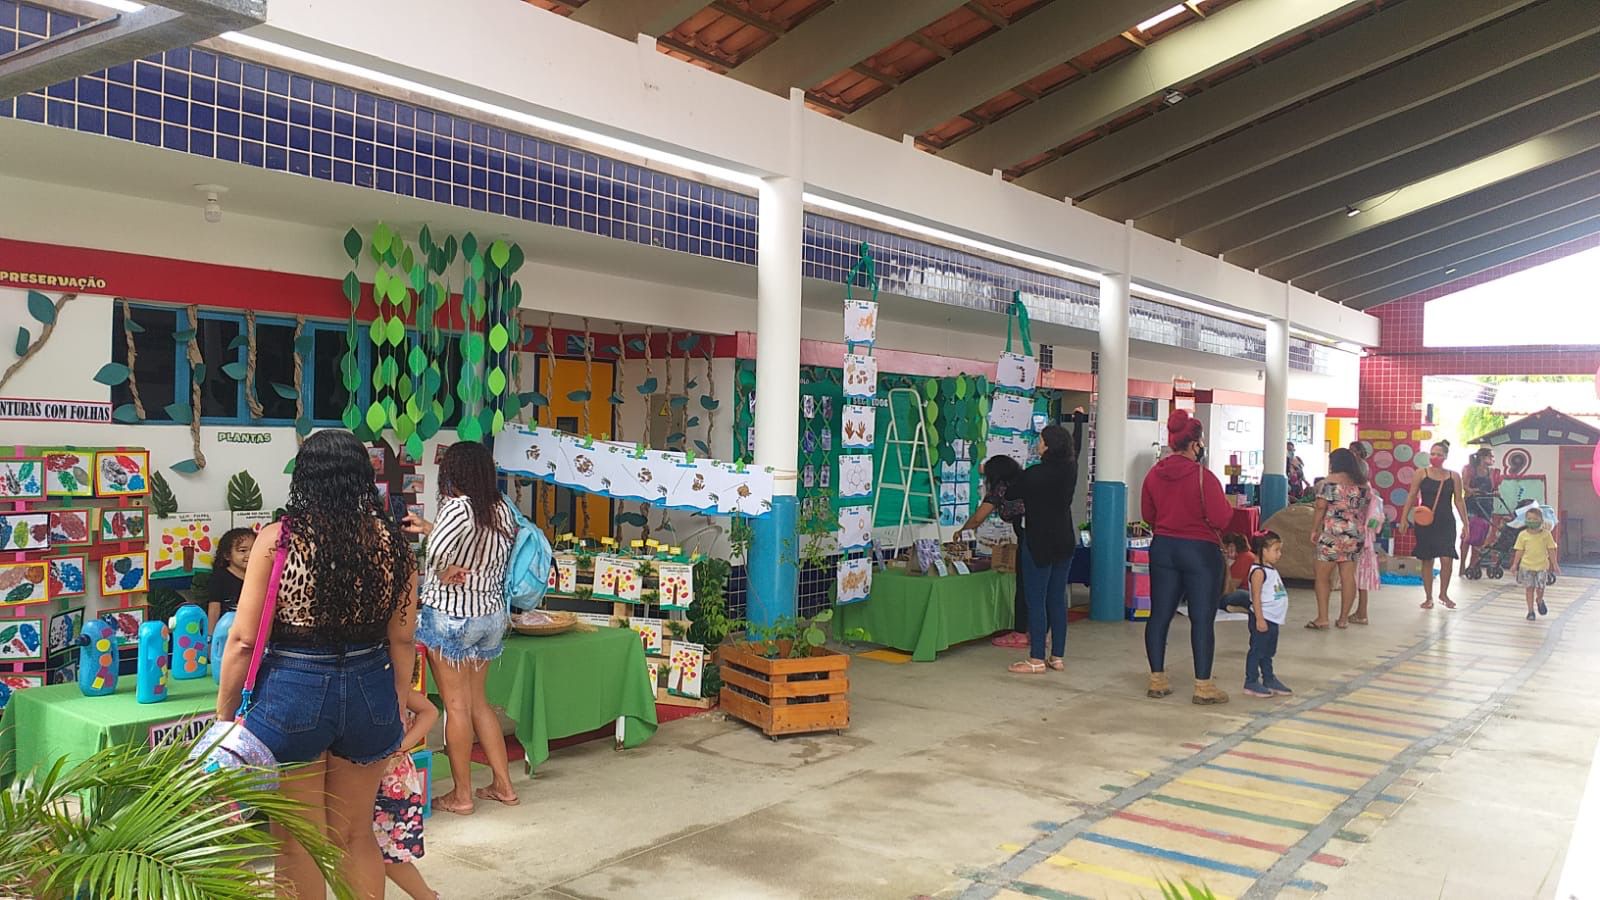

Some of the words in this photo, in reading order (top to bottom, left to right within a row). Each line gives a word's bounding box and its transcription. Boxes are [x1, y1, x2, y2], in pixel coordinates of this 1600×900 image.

[0, 271, 106, 290] PRESERVAÇÃO
[44, 403, 67, 419] COM
[70, 405, 110, 421] FOLHAS
[217, 432, 272, 444] PLANTAS
